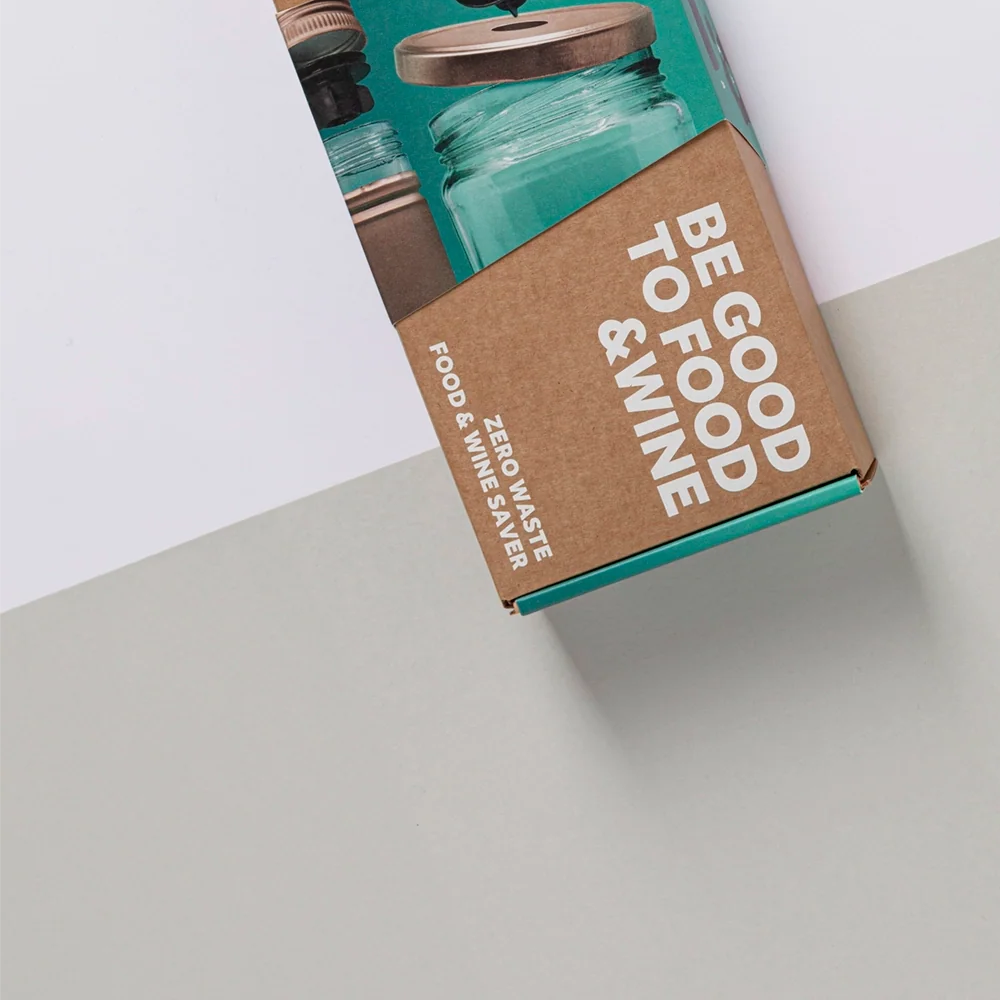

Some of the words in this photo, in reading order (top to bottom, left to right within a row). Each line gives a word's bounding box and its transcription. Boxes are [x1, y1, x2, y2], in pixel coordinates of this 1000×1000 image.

[627, 220, 691, 313] TO
[428, 341, 467, 408] FOOD
[676, 201, 745, 288] BE
[712, 290, 811, 473] GOOD
[455, 412, 475, 430] &
[658, 318, 758, 492] FOOD
[463, 429, 500, 493] WINE
[483, 414, 520, 477] ZERO
[508, 478, 553, 562] WASTE
[486, 494, 529, 571] SAVER
